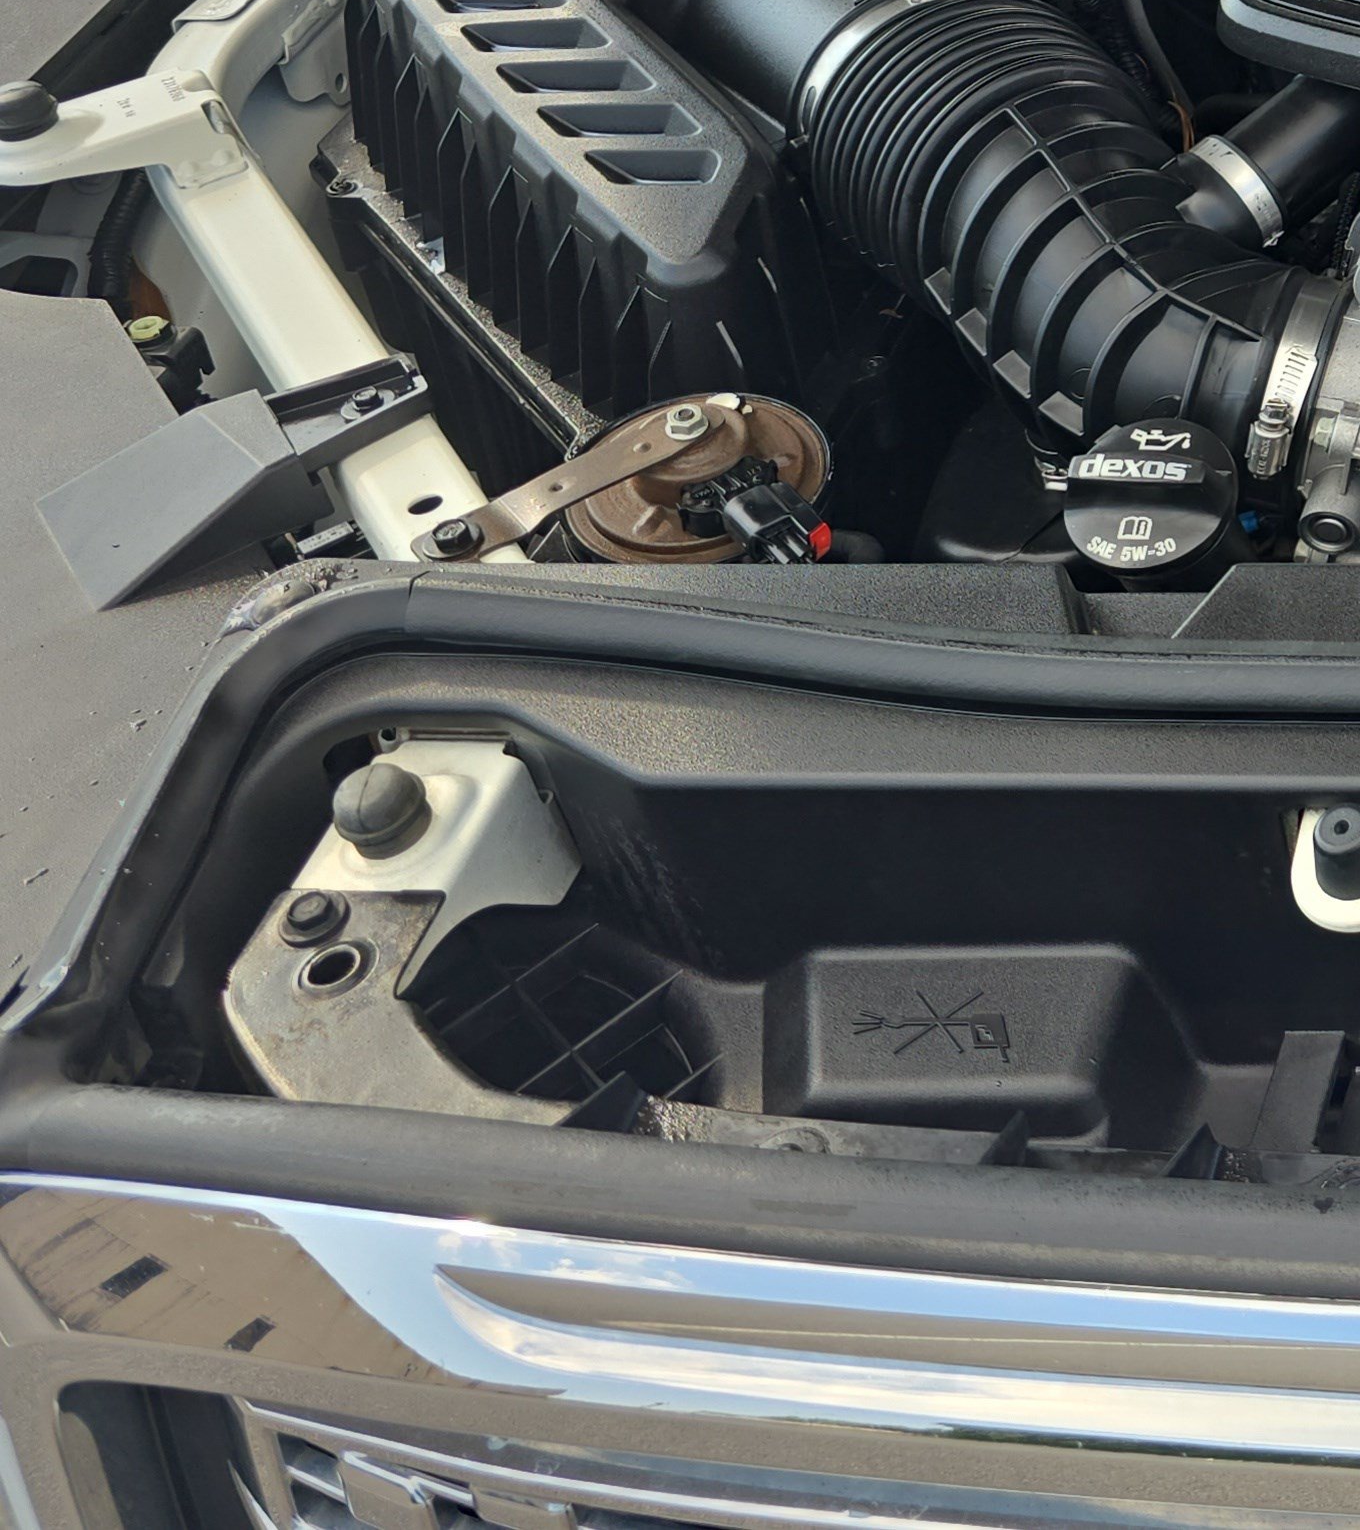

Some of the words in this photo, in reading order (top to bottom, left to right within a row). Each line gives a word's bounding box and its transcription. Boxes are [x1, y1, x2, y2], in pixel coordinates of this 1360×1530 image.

[1078, 453, 1187, 482] dexos
[1086, 536, 1117, 560] SAE
[1120, 537, 1176, 562] 5W-30
